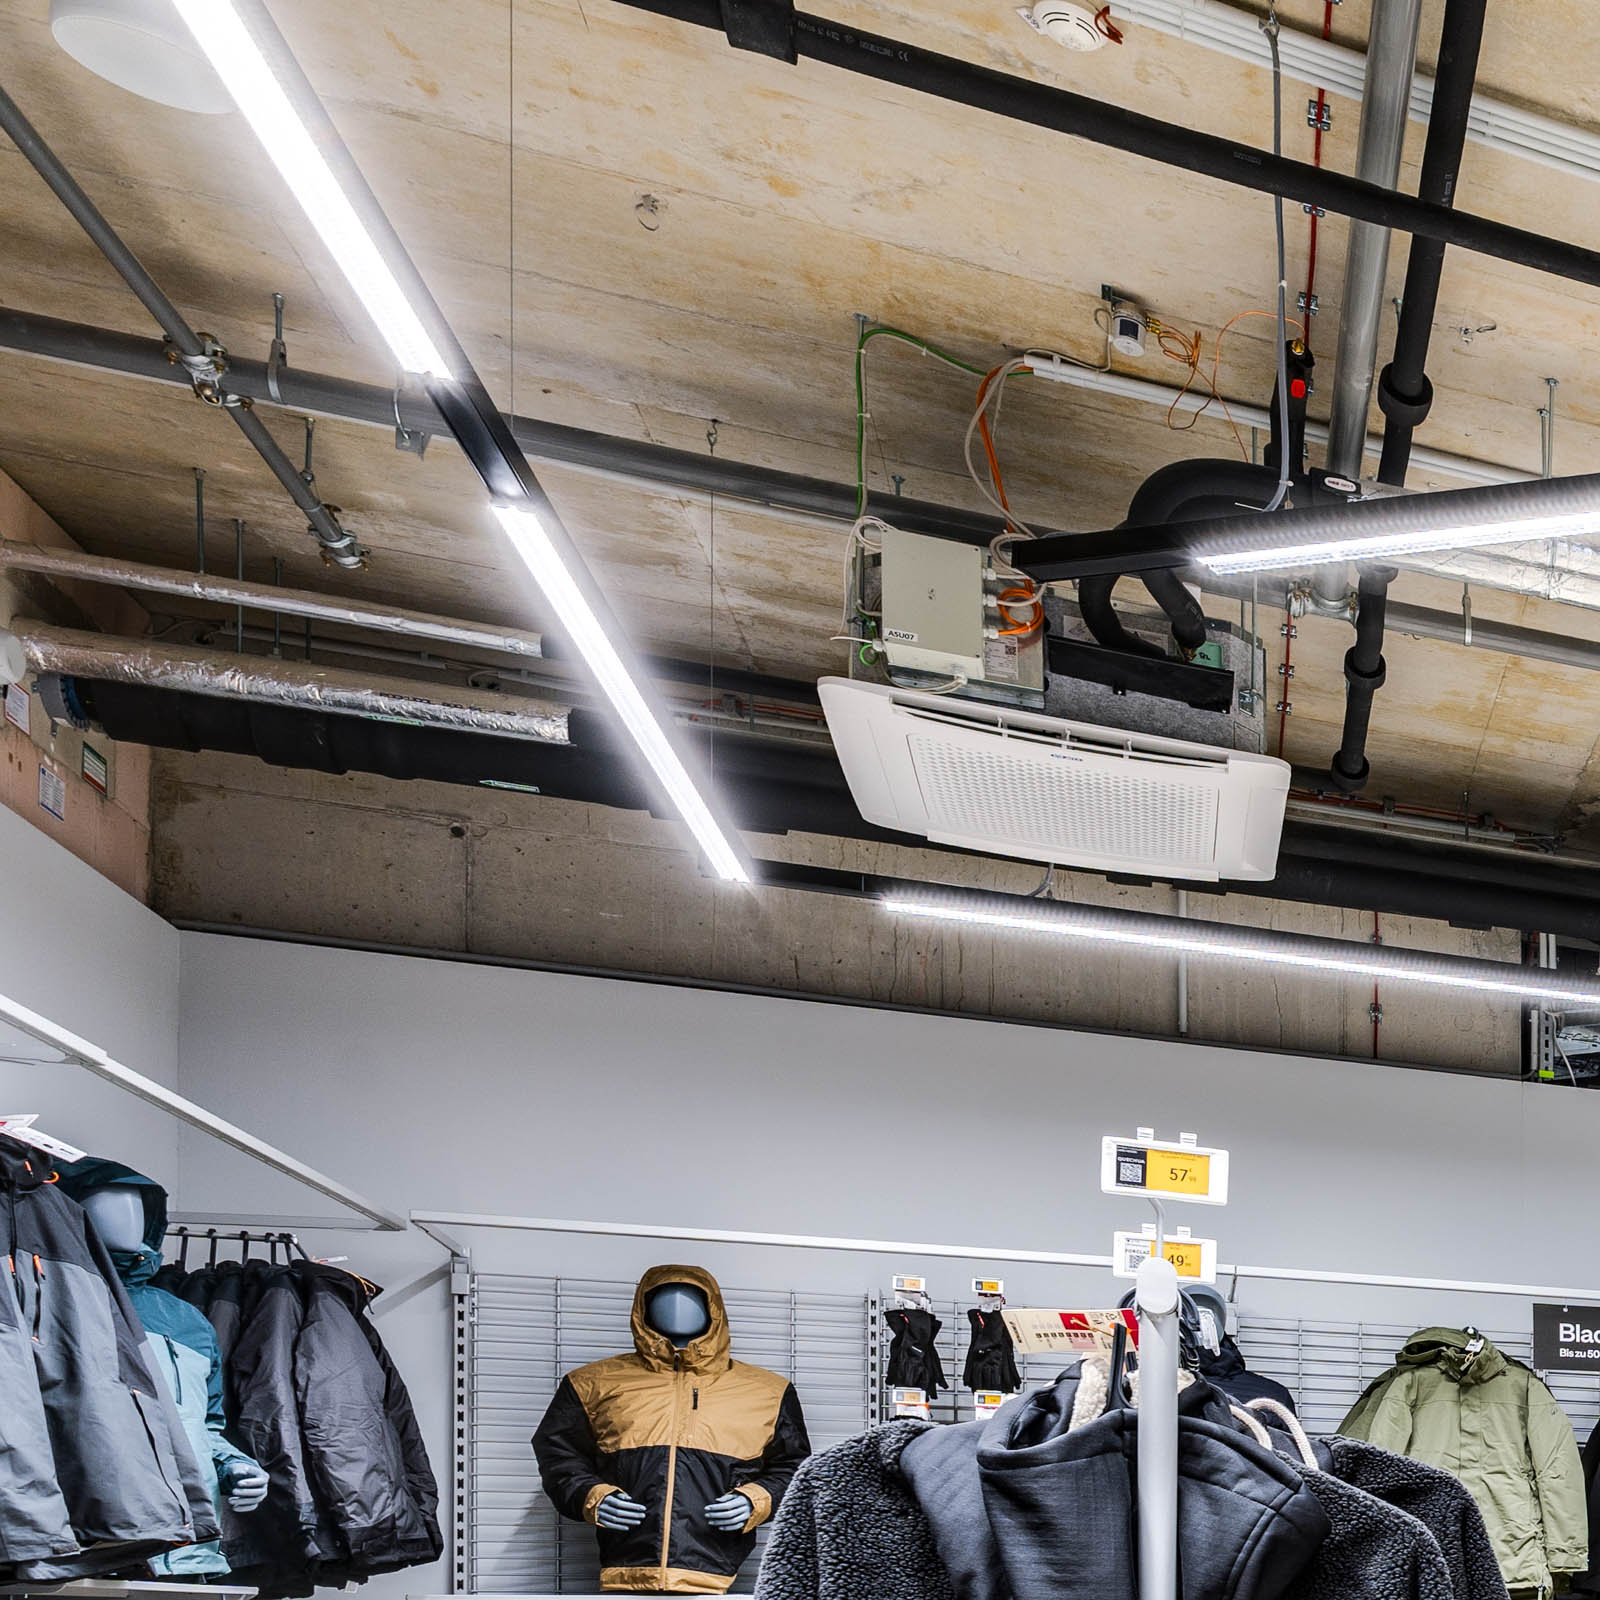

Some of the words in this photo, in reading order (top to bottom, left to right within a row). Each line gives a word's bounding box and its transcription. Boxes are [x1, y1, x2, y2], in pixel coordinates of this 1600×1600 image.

[888, 630, 914, 640] ASU07
[1169, 1167, 1188, 1182] 57
[1167, 1255, 1184, 1267] 49
[1559, 1347, 1574, 1358] Bis
[1575, 1350, 1586, 1358] zu
